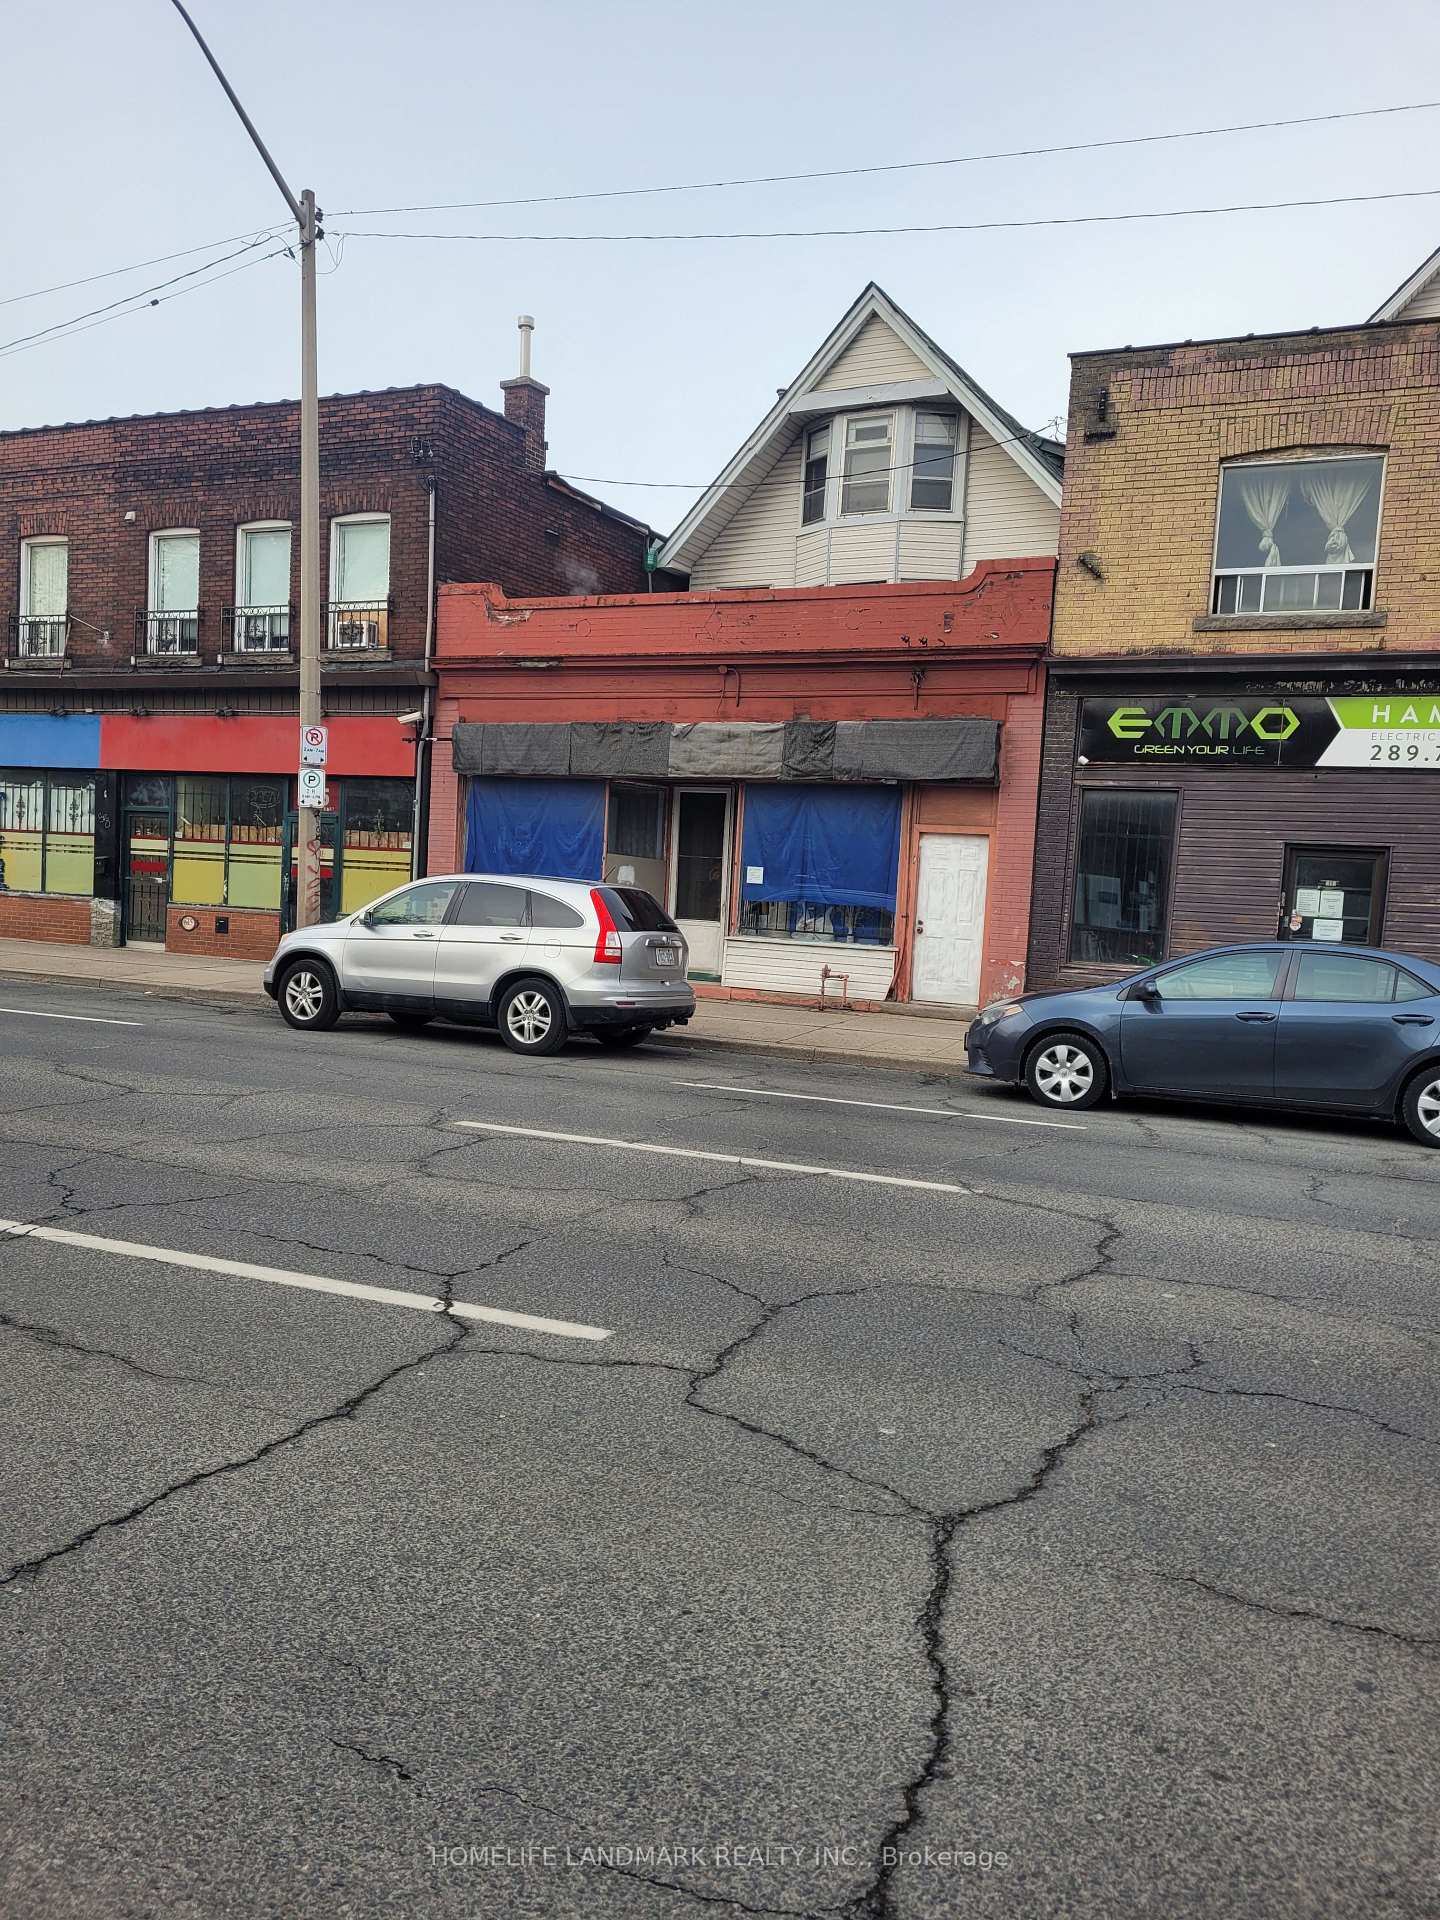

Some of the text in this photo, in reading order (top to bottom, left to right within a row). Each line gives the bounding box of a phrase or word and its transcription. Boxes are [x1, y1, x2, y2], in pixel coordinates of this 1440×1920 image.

[1107, 707, 1300, 740] EMMO
[1371, 732, 1436, 741] ELECTRIC
[1134, 744, 1265, 755] GREEN YOUR LIFE
